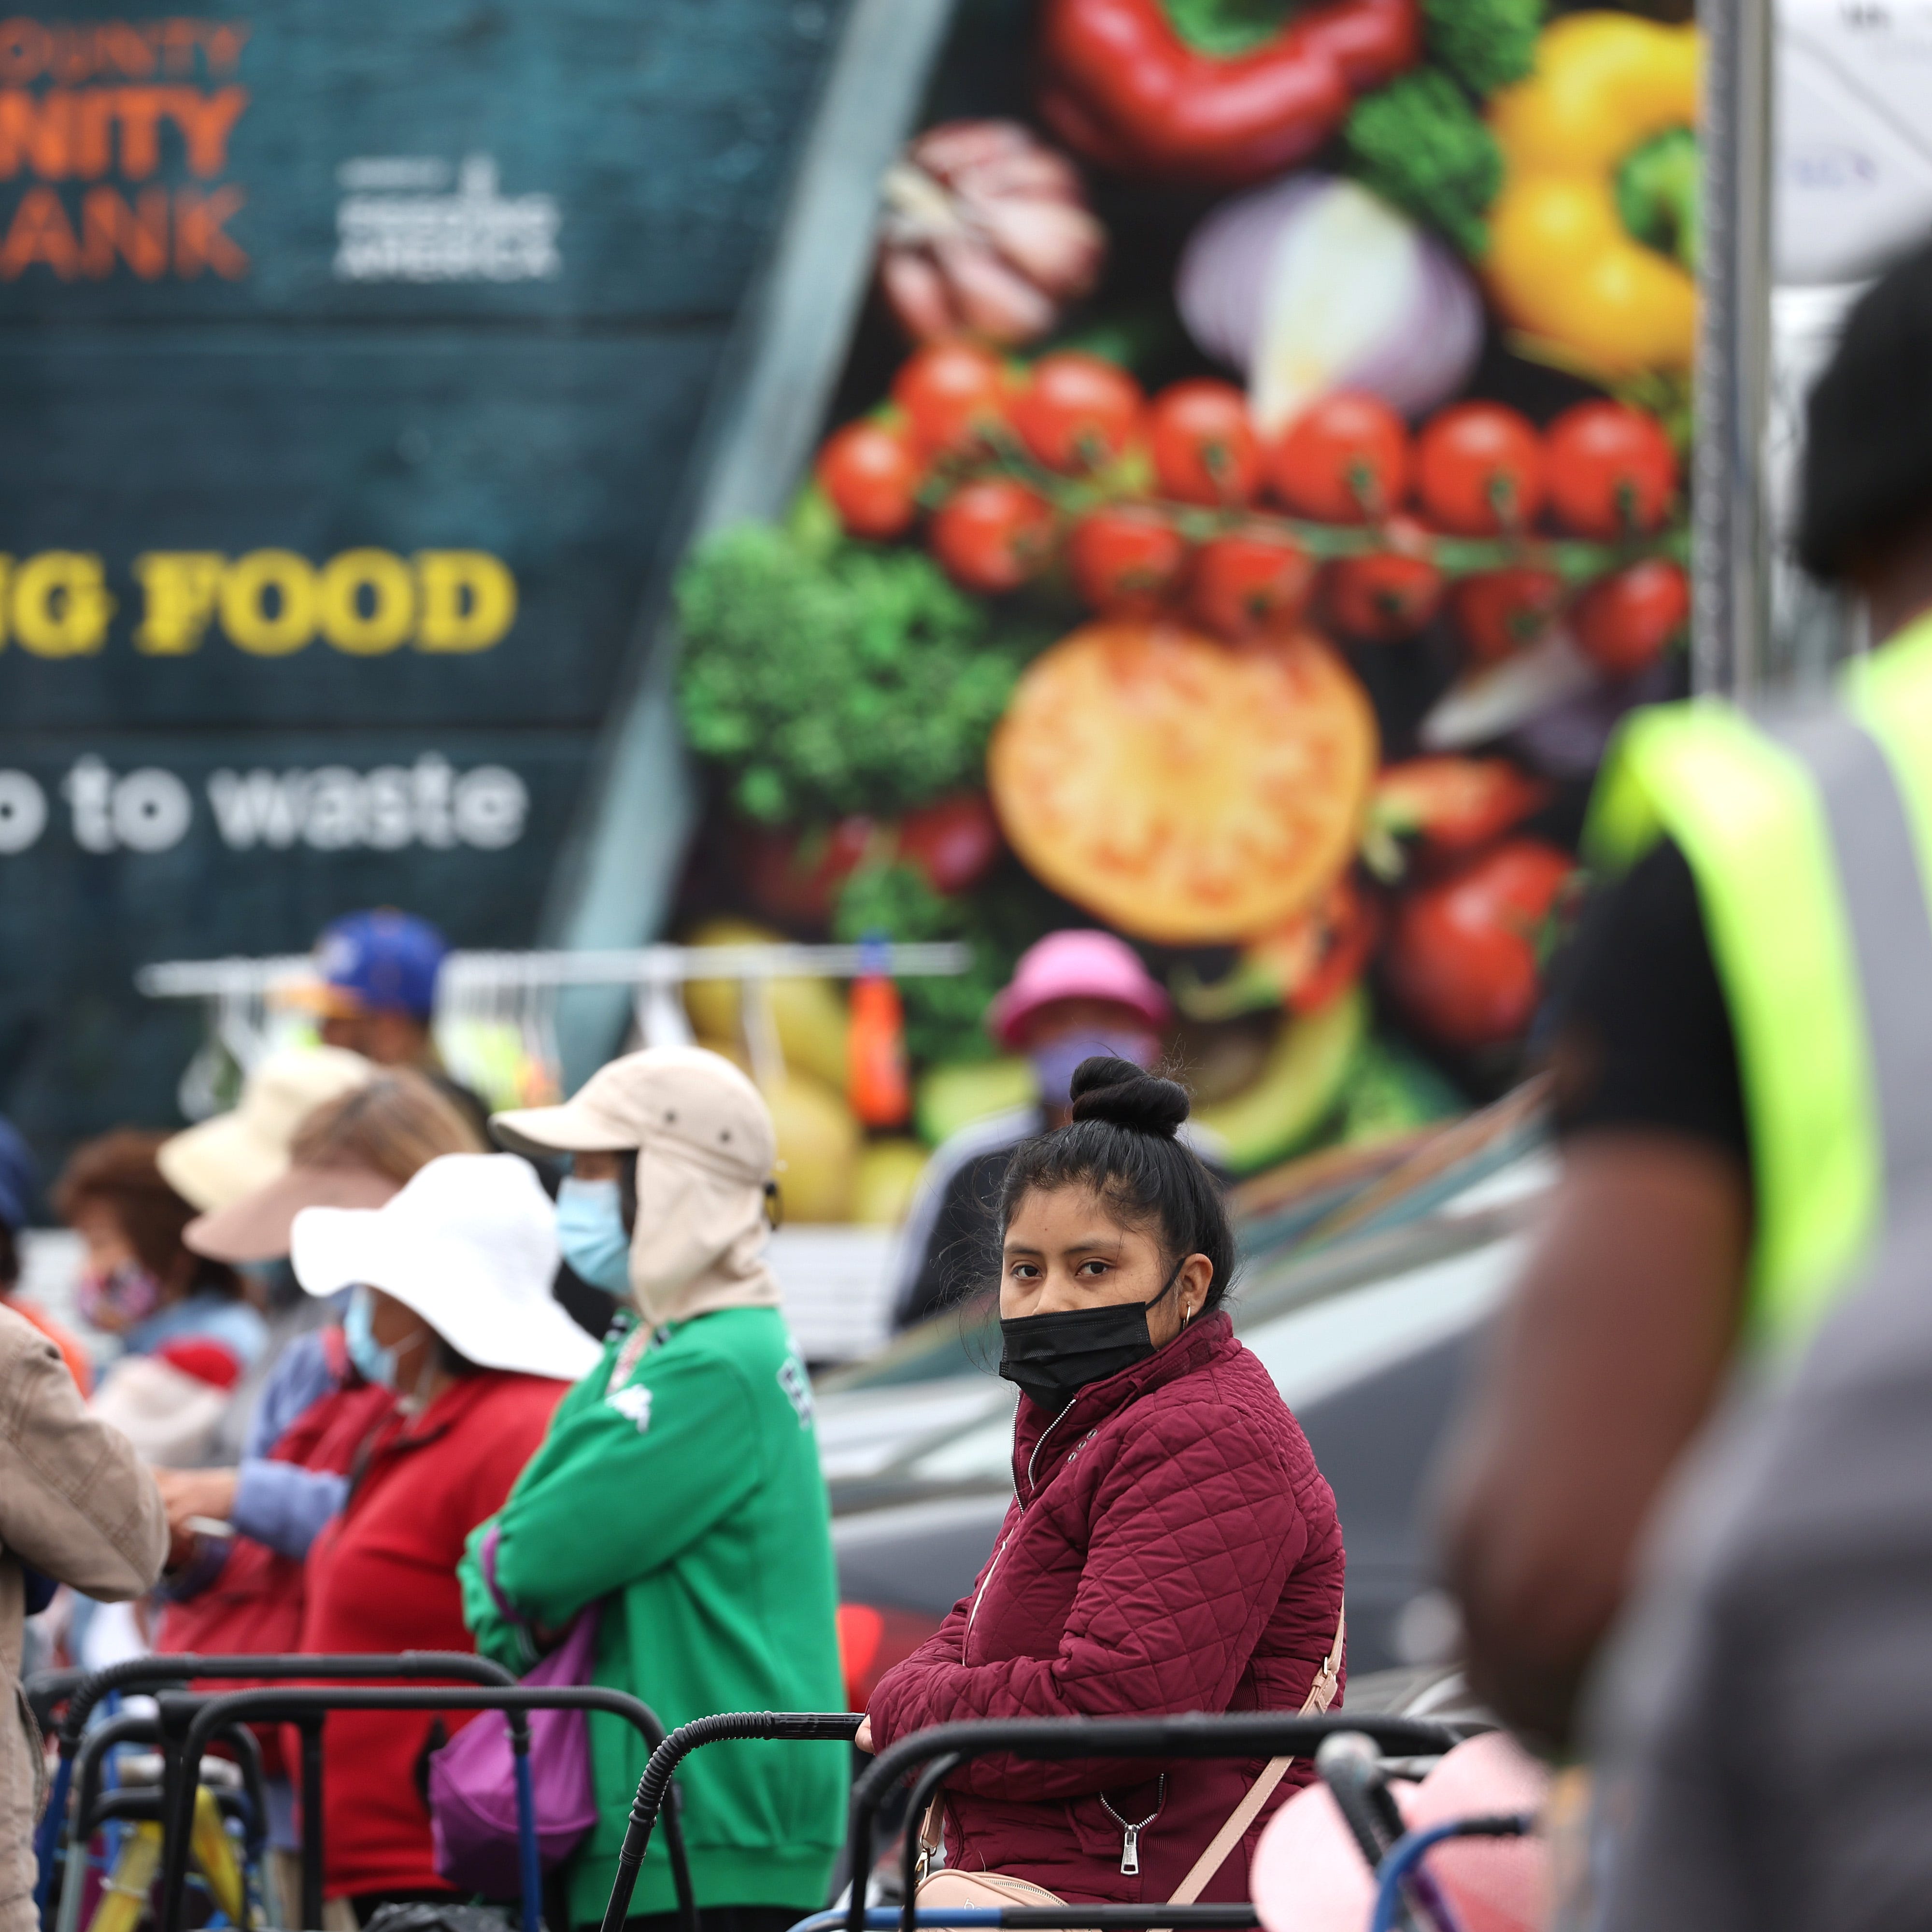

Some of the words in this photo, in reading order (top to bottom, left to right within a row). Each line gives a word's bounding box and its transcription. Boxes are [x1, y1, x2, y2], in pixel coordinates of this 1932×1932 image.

[134, 548, 516, 655] FOOD
[62, 753, 191, 853] to
[208, 752, 528, 850] waste
